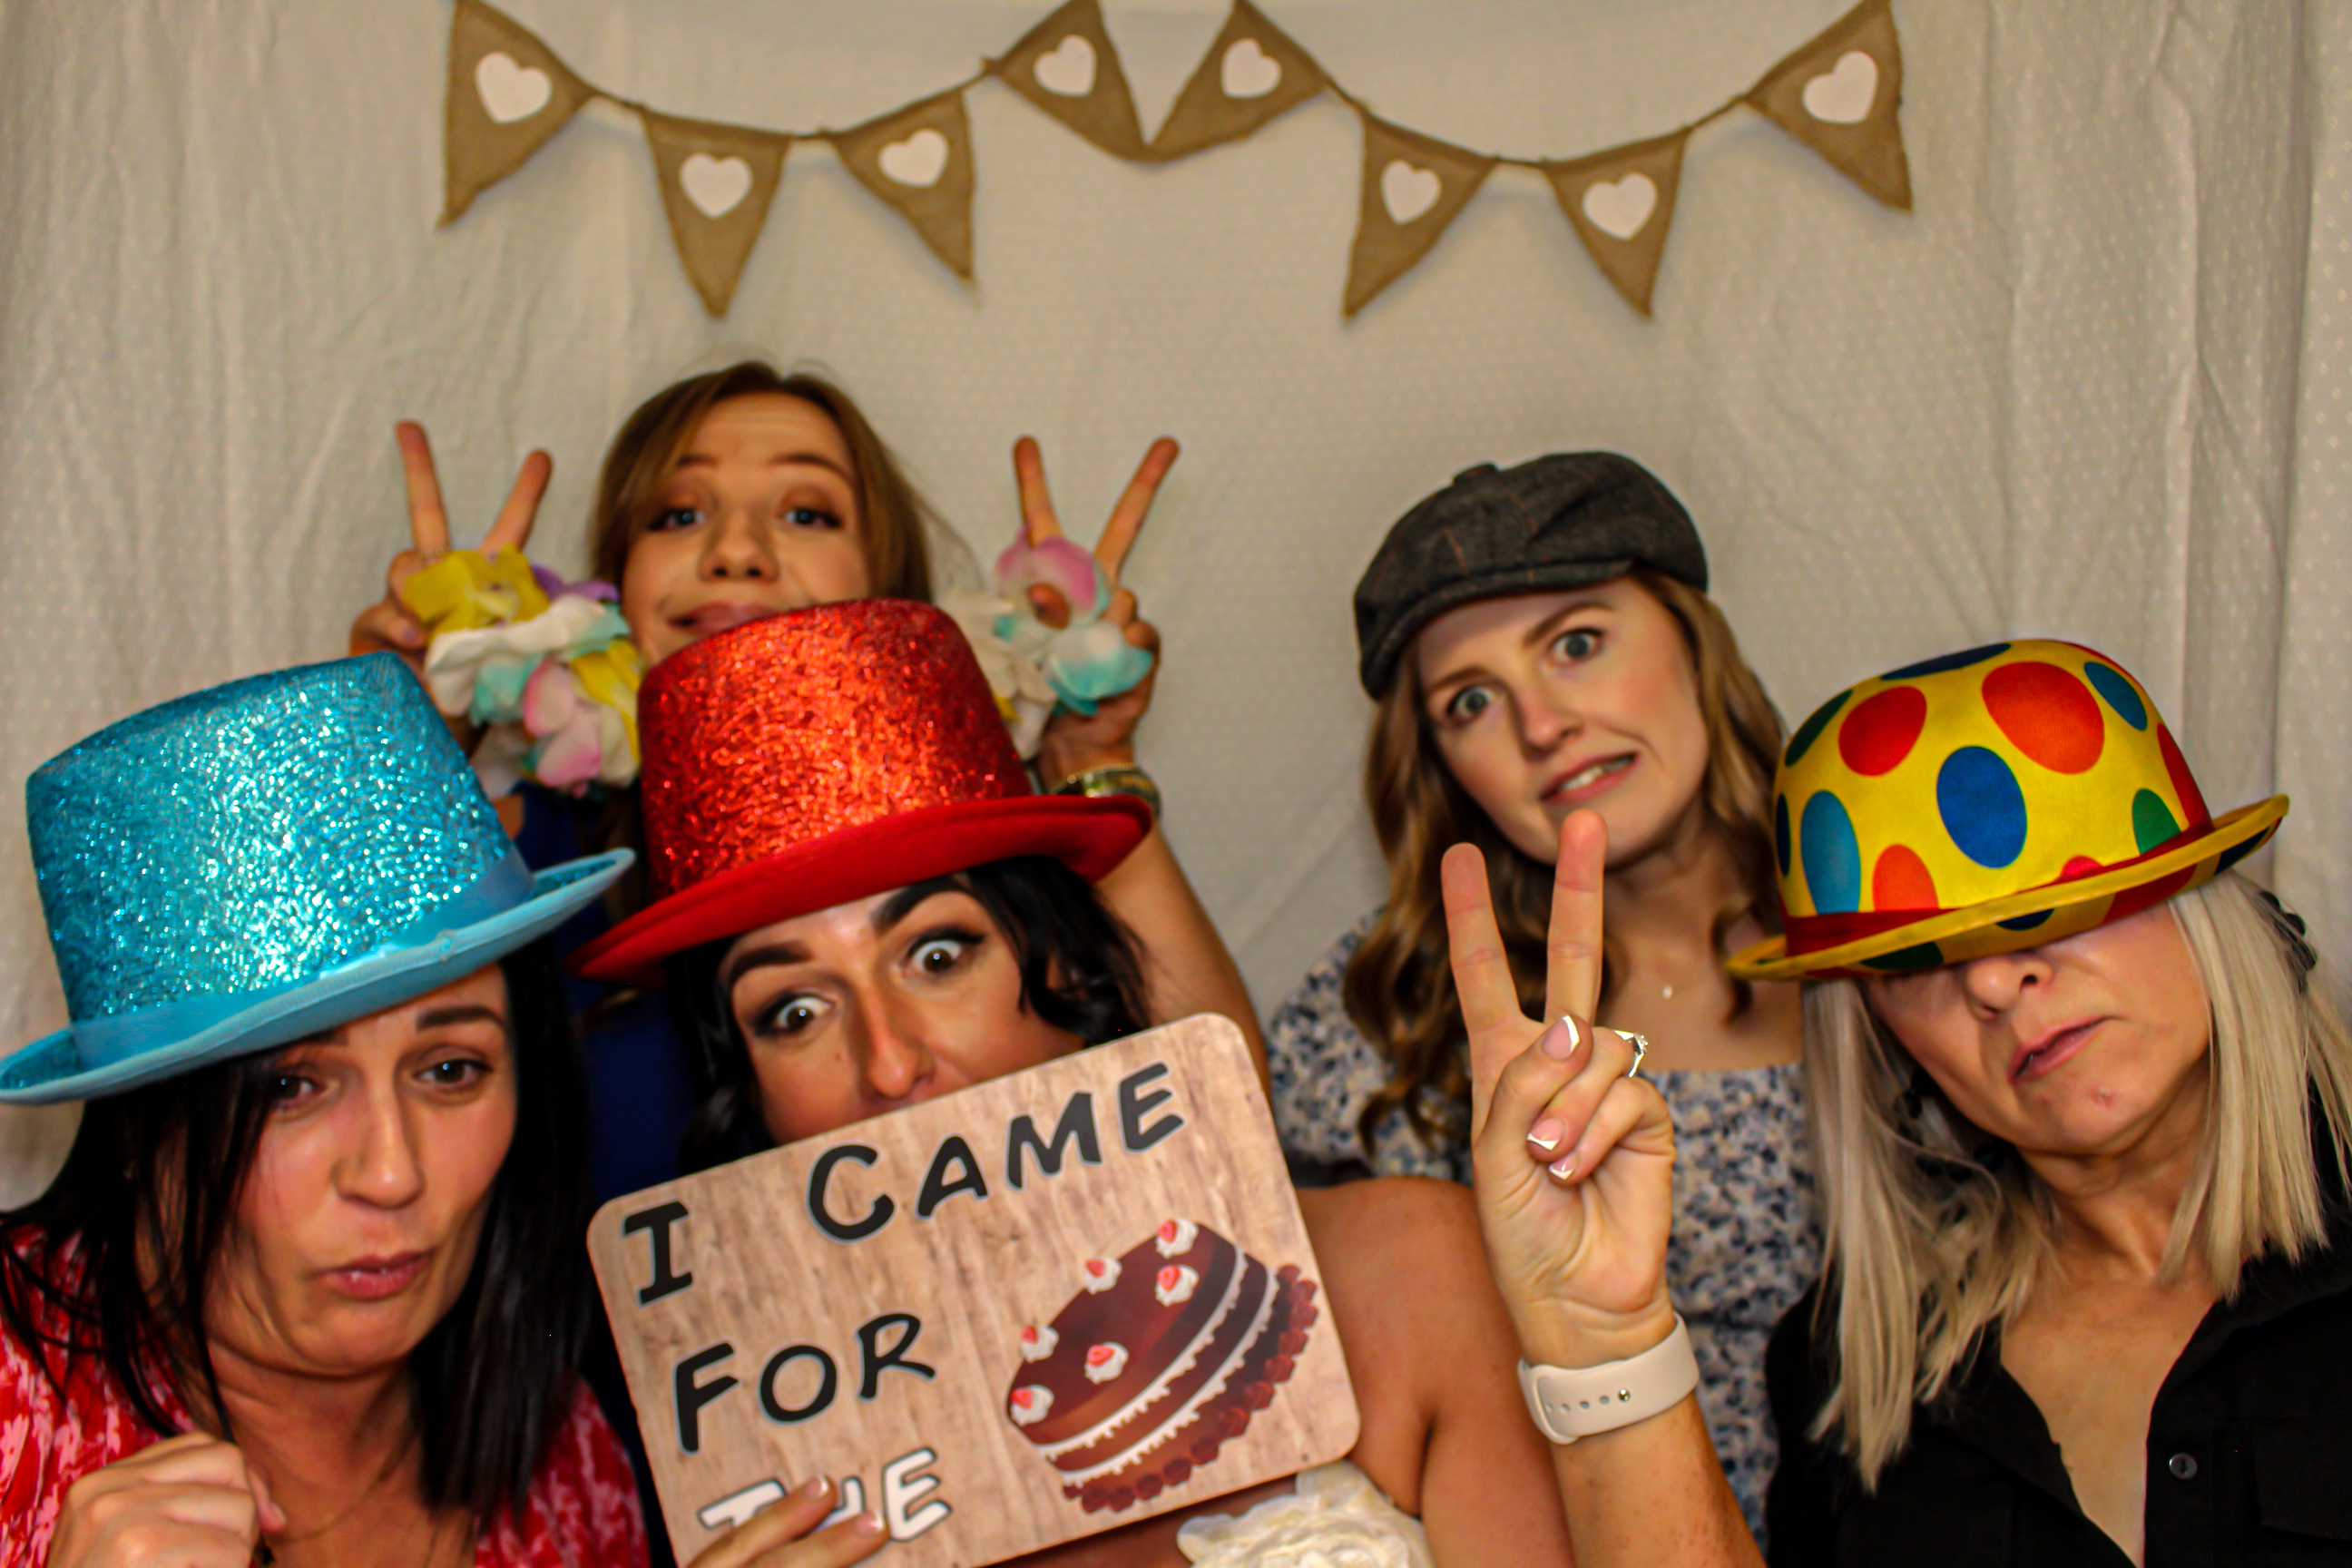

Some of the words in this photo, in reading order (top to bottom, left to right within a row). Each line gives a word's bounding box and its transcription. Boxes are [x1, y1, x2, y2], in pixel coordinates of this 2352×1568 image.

[622, 1200, 693, 1307] I
[806, 1061, 1186, 1242] CAME
[672, 1312, 936, 1453] FOR
